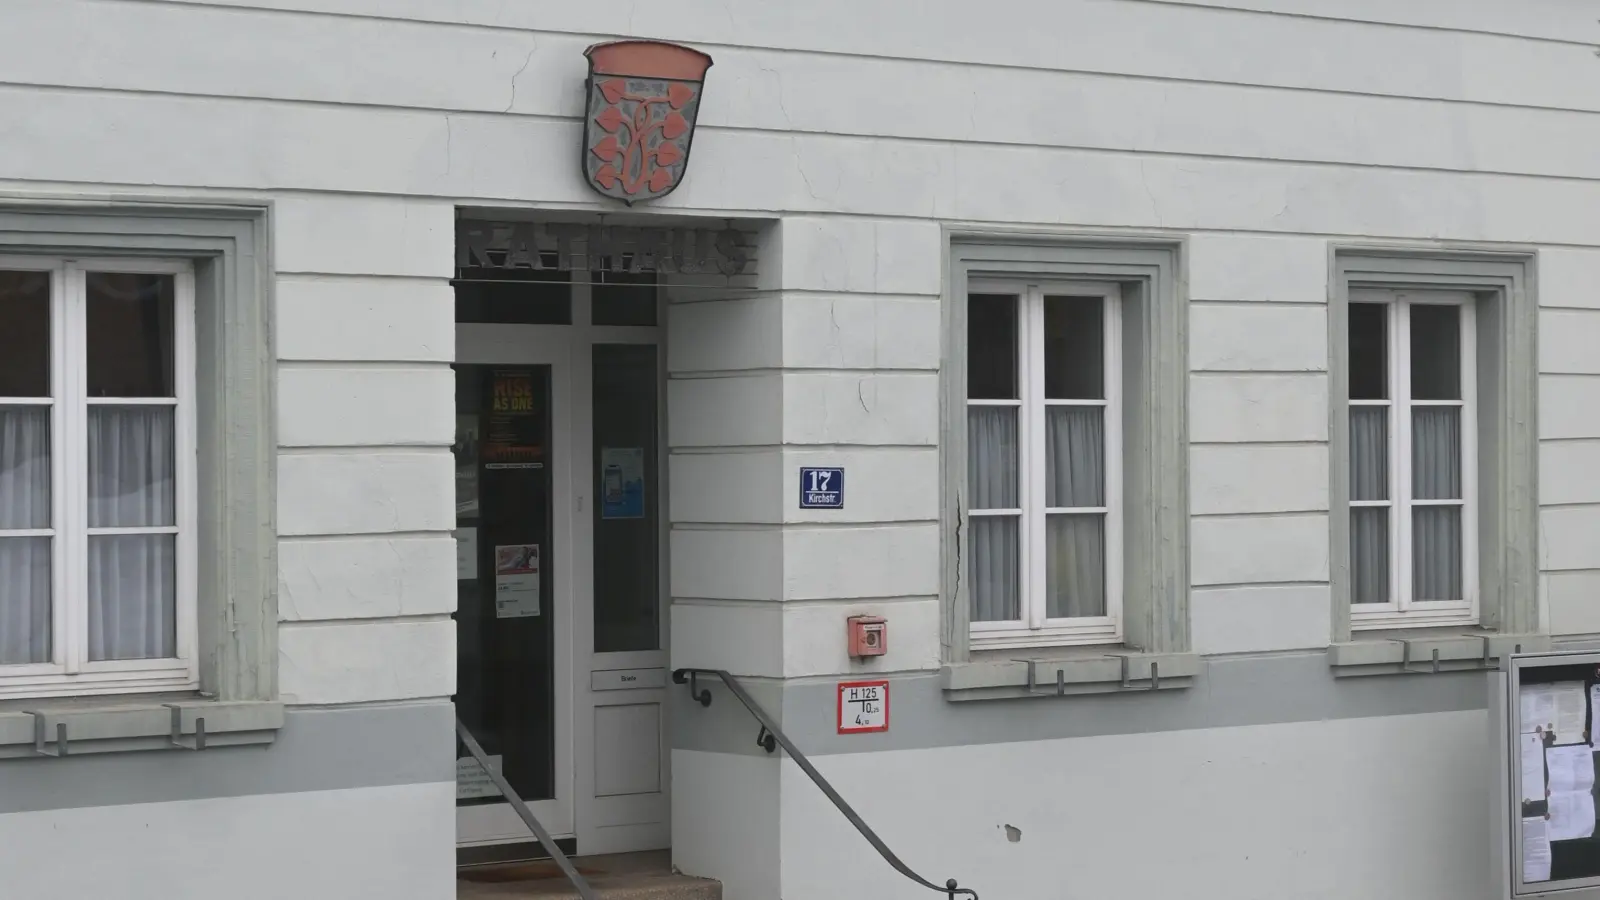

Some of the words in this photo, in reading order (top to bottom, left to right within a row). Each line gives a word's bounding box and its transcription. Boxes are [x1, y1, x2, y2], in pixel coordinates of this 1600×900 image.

[455, 221, 751, 276] RATHAUS
[493, 378, 532, 397] RISE
[493, 397, 509, 411] AS
[511, 396, 533, 411] ONE
[809, 471, 832, 491] 17
[808, 493, 836, 503] Kirchstr.
[850, 688, 858, 699] H
[862, 687, 877, 699] 125
